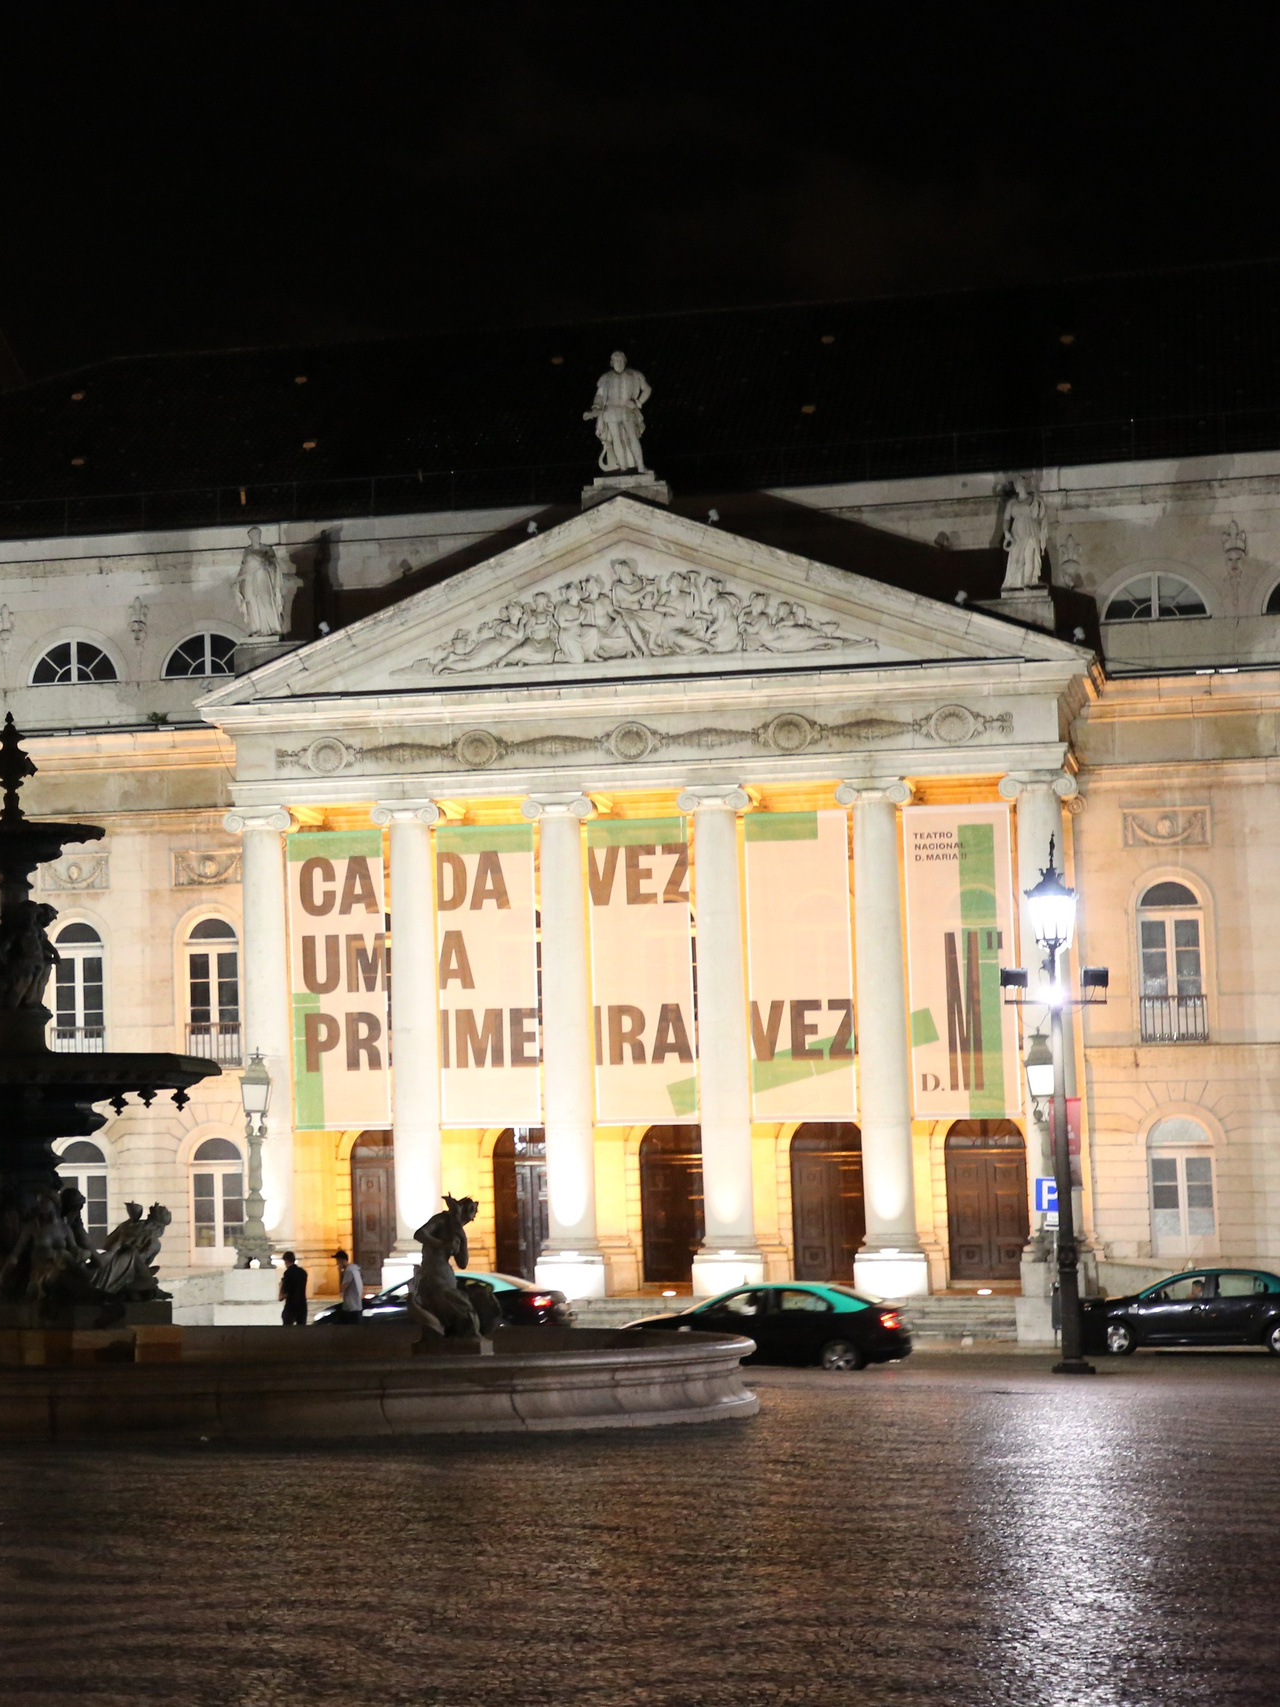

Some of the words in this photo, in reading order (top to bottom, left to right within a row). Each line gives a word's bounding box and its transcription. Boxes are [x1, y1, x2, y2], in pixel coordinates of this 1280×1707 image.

[913, 831, 953, 840] TEATRO
[914, 842, 966, 851] NACIONAL
[915, 854, 925, 862] D.
[926, 853, 959, 861] MARIA
[587, 842, 690, 906] VEZ
[749, 998, 855, 1062] VEZ
[1041, 1180, 1059, 1210] P
